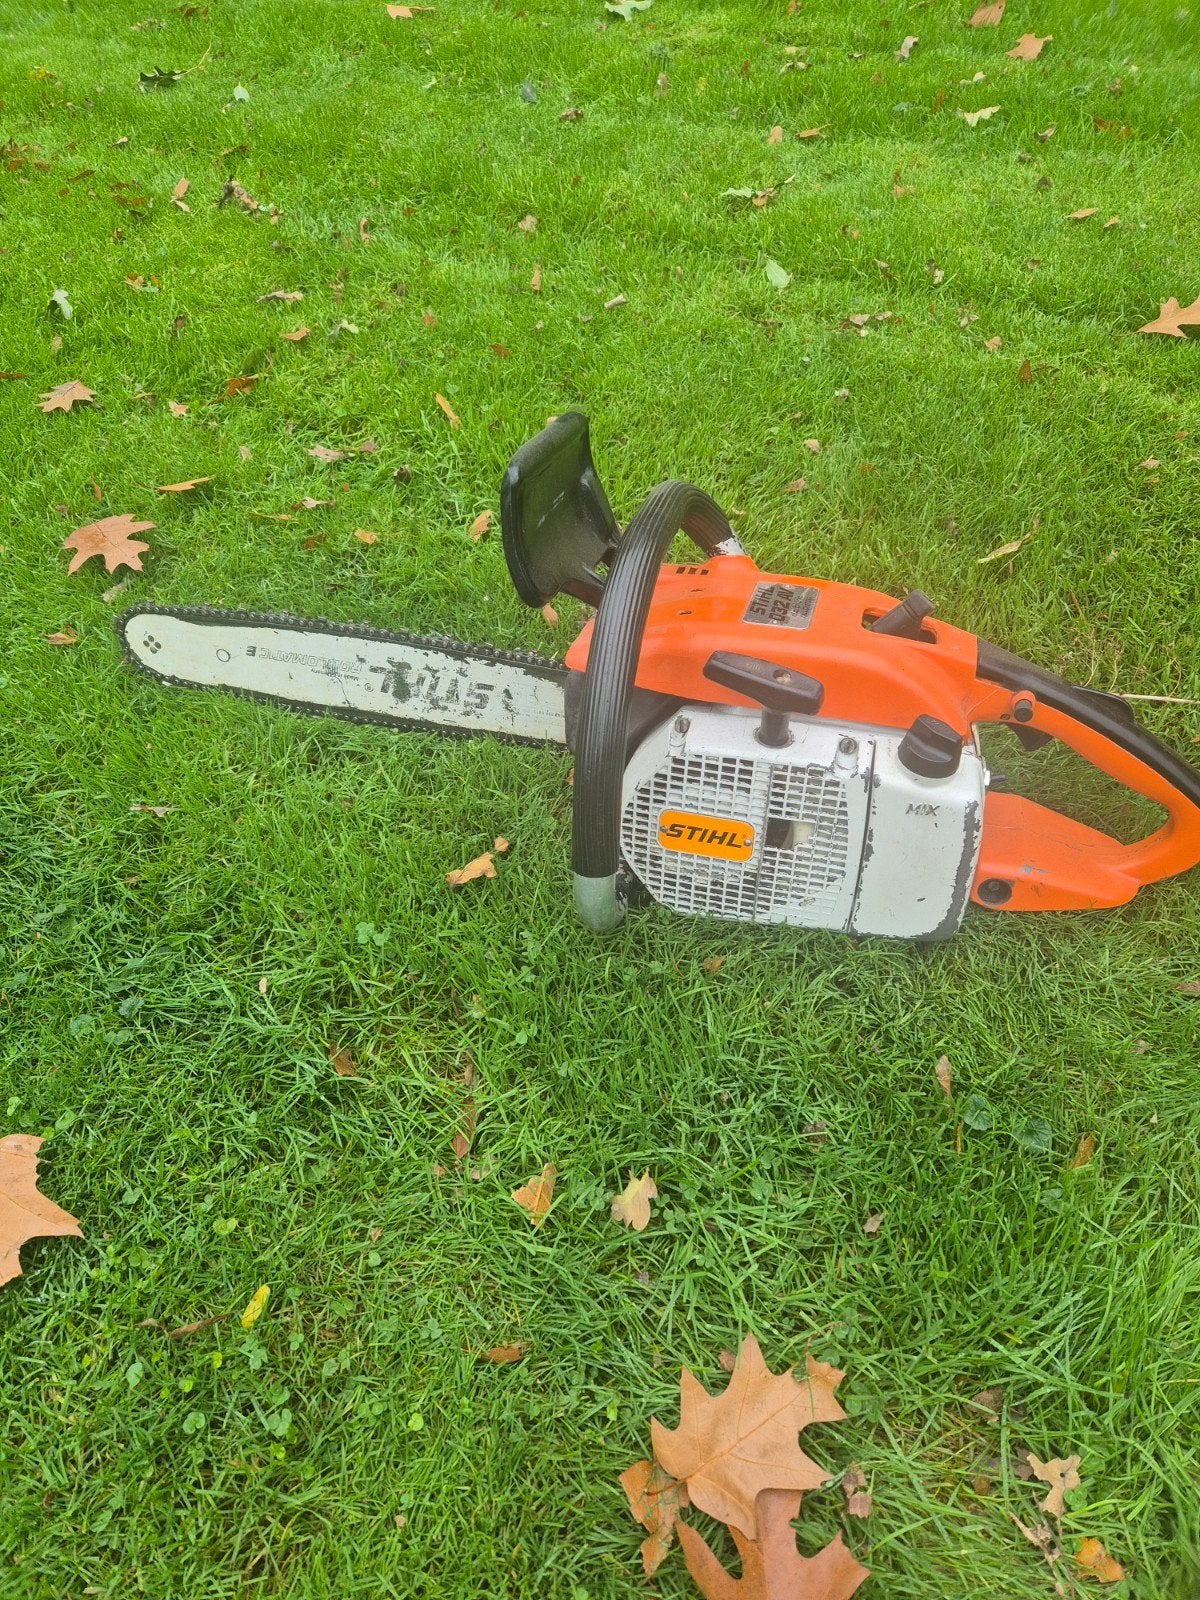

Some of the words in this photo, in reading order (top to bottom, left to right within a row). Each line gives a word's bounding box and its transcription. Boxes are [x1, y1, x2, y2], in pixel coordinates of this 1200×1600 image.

[749, 586, 774, 615] STIHL
[769, 600, 791, 621] 032
[245, 645, 257, 657] E
[905, 803, 941, 817] MIX
[665, 823, 743, 849] STIHL
